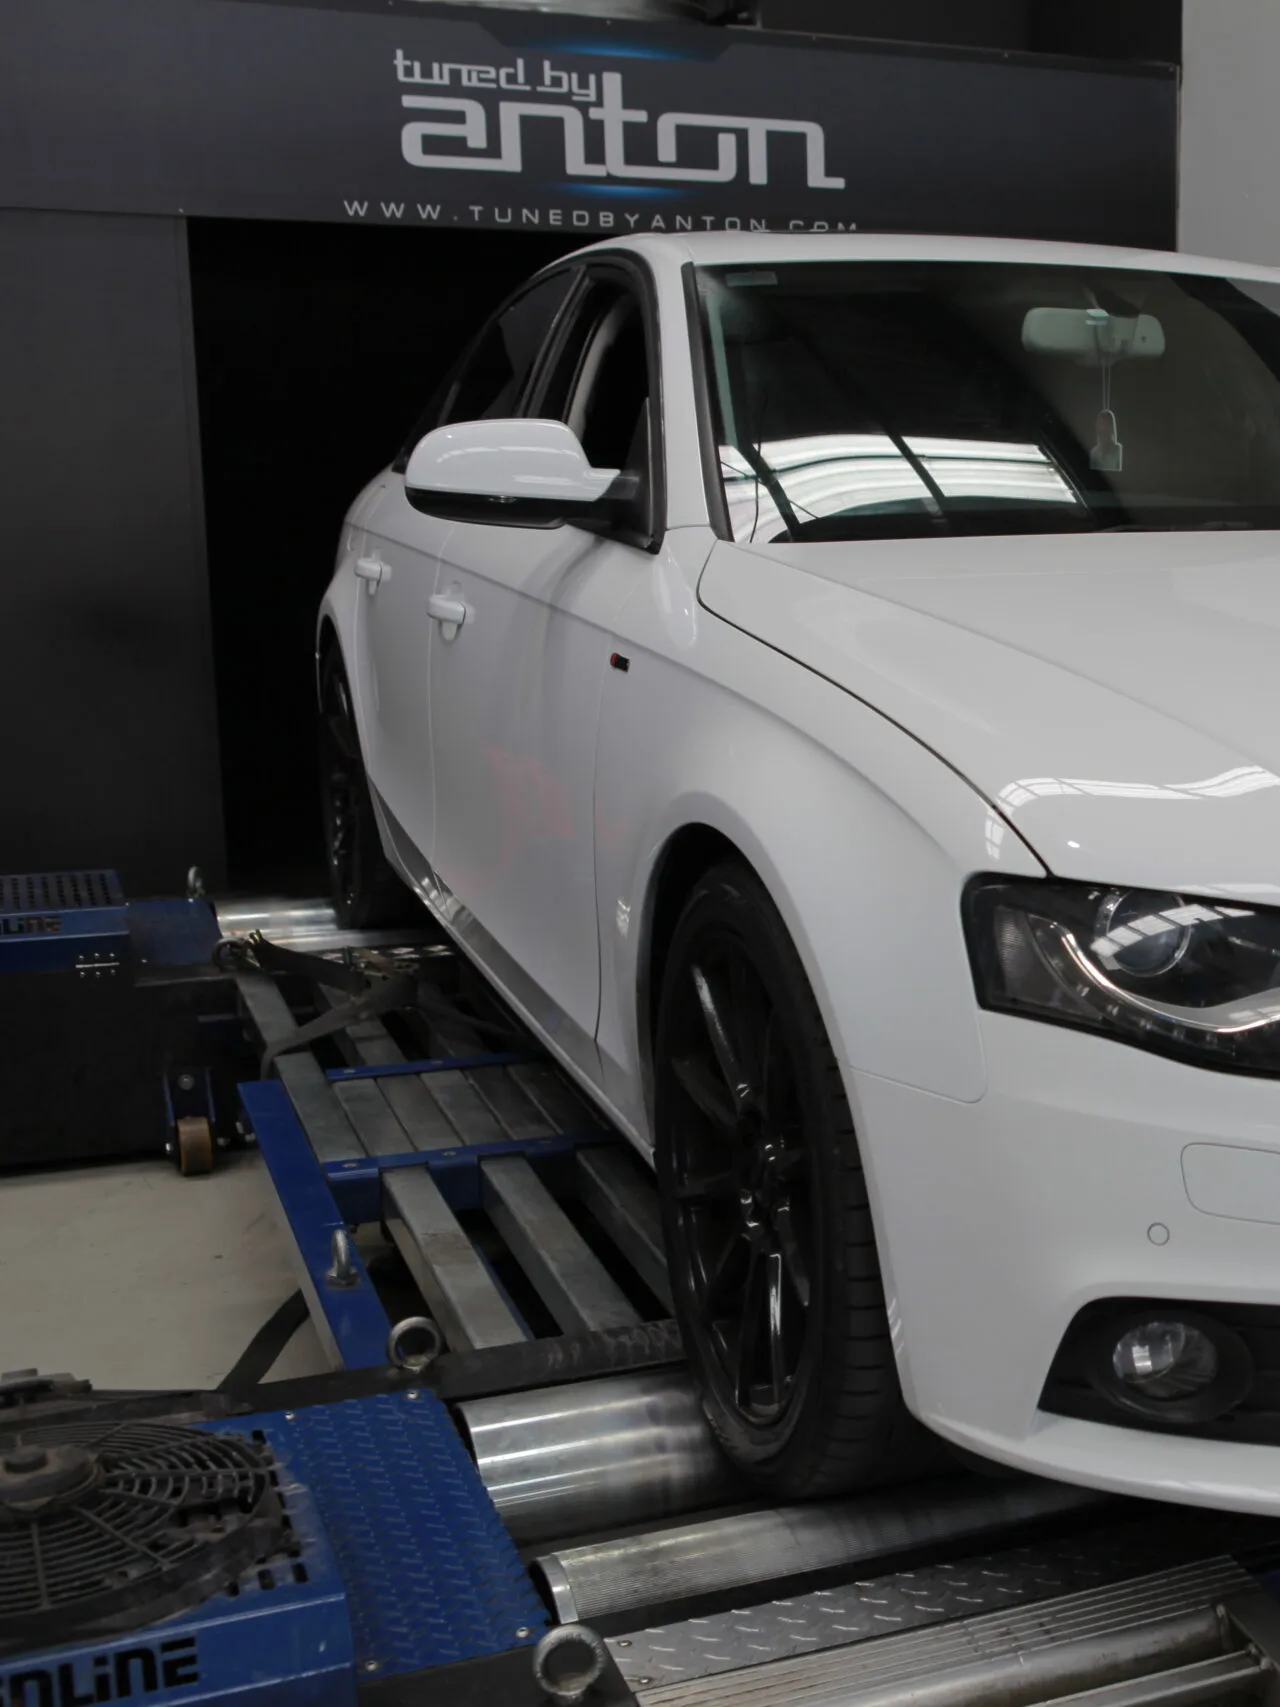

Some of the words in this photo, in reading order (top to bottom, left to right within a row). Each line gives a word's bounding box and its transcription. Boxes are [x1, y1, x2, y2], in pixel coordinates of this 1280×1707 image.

[394, 49, 531, 91] tuned
[536, 59, 597, 102] by
[401, 71, 846, 190] anton
[343, 199, 857, 233] WWW.TUNEDBYANTONCOM
